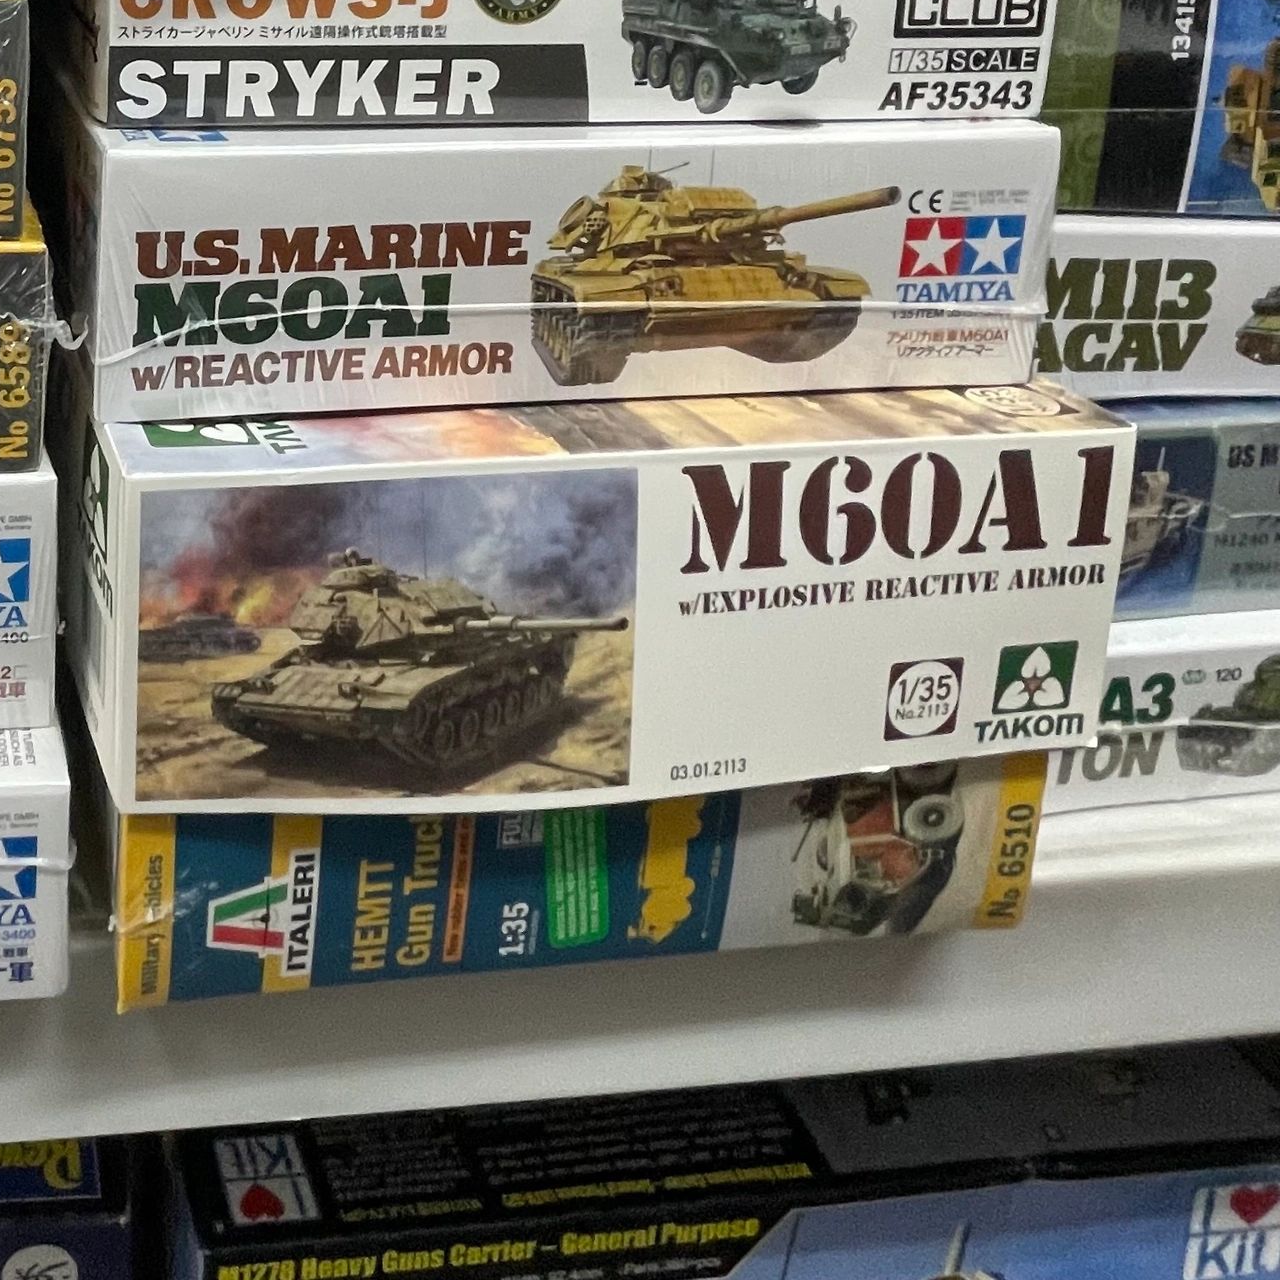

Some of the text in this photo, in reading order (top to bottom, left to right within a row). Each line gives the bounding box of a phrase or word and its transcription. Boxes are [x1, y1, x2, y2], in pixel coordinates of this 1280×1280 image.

[891, 48, 1038, 73] 1/35 SCALE
[115, 58, 502, 120] STRYKER
[877, 80, 1034, 113] AF35343
[135, 220, 532, 279] U.S. MARINE
[132, 272, 453, 348] M60A1
[896, 280, 1015, 304] TAMIYA
[131, 342, 515, 391] w/REACTIVE ARMOR
[1033, 321, 1209, 373] ACAV
[679, 445, 1115, 575] M60A1
[677, 562, 1105, 617] w/EXPLOSIVE REACTIVE ARMOR
[898, 673, 954, 706] 1/35
[1097, 671, 1176, 726] A3
[1215, 666, 1243, 683] 120
[894, 702, 951, 722] No.2113
[670, 757, 747, 782] 03.01.2113
[987, 803, 1036, 919] No 6510
[286, 853, 316, 971] ITALERI
[395, 901, 436, 967] Gun
[498, 901, 530, 957] 1:35
[448, 1239, 537, 1267] Carrier
[560, 1224, 659, 1256] General
[660, 1217, 761, 1246] Purpose
